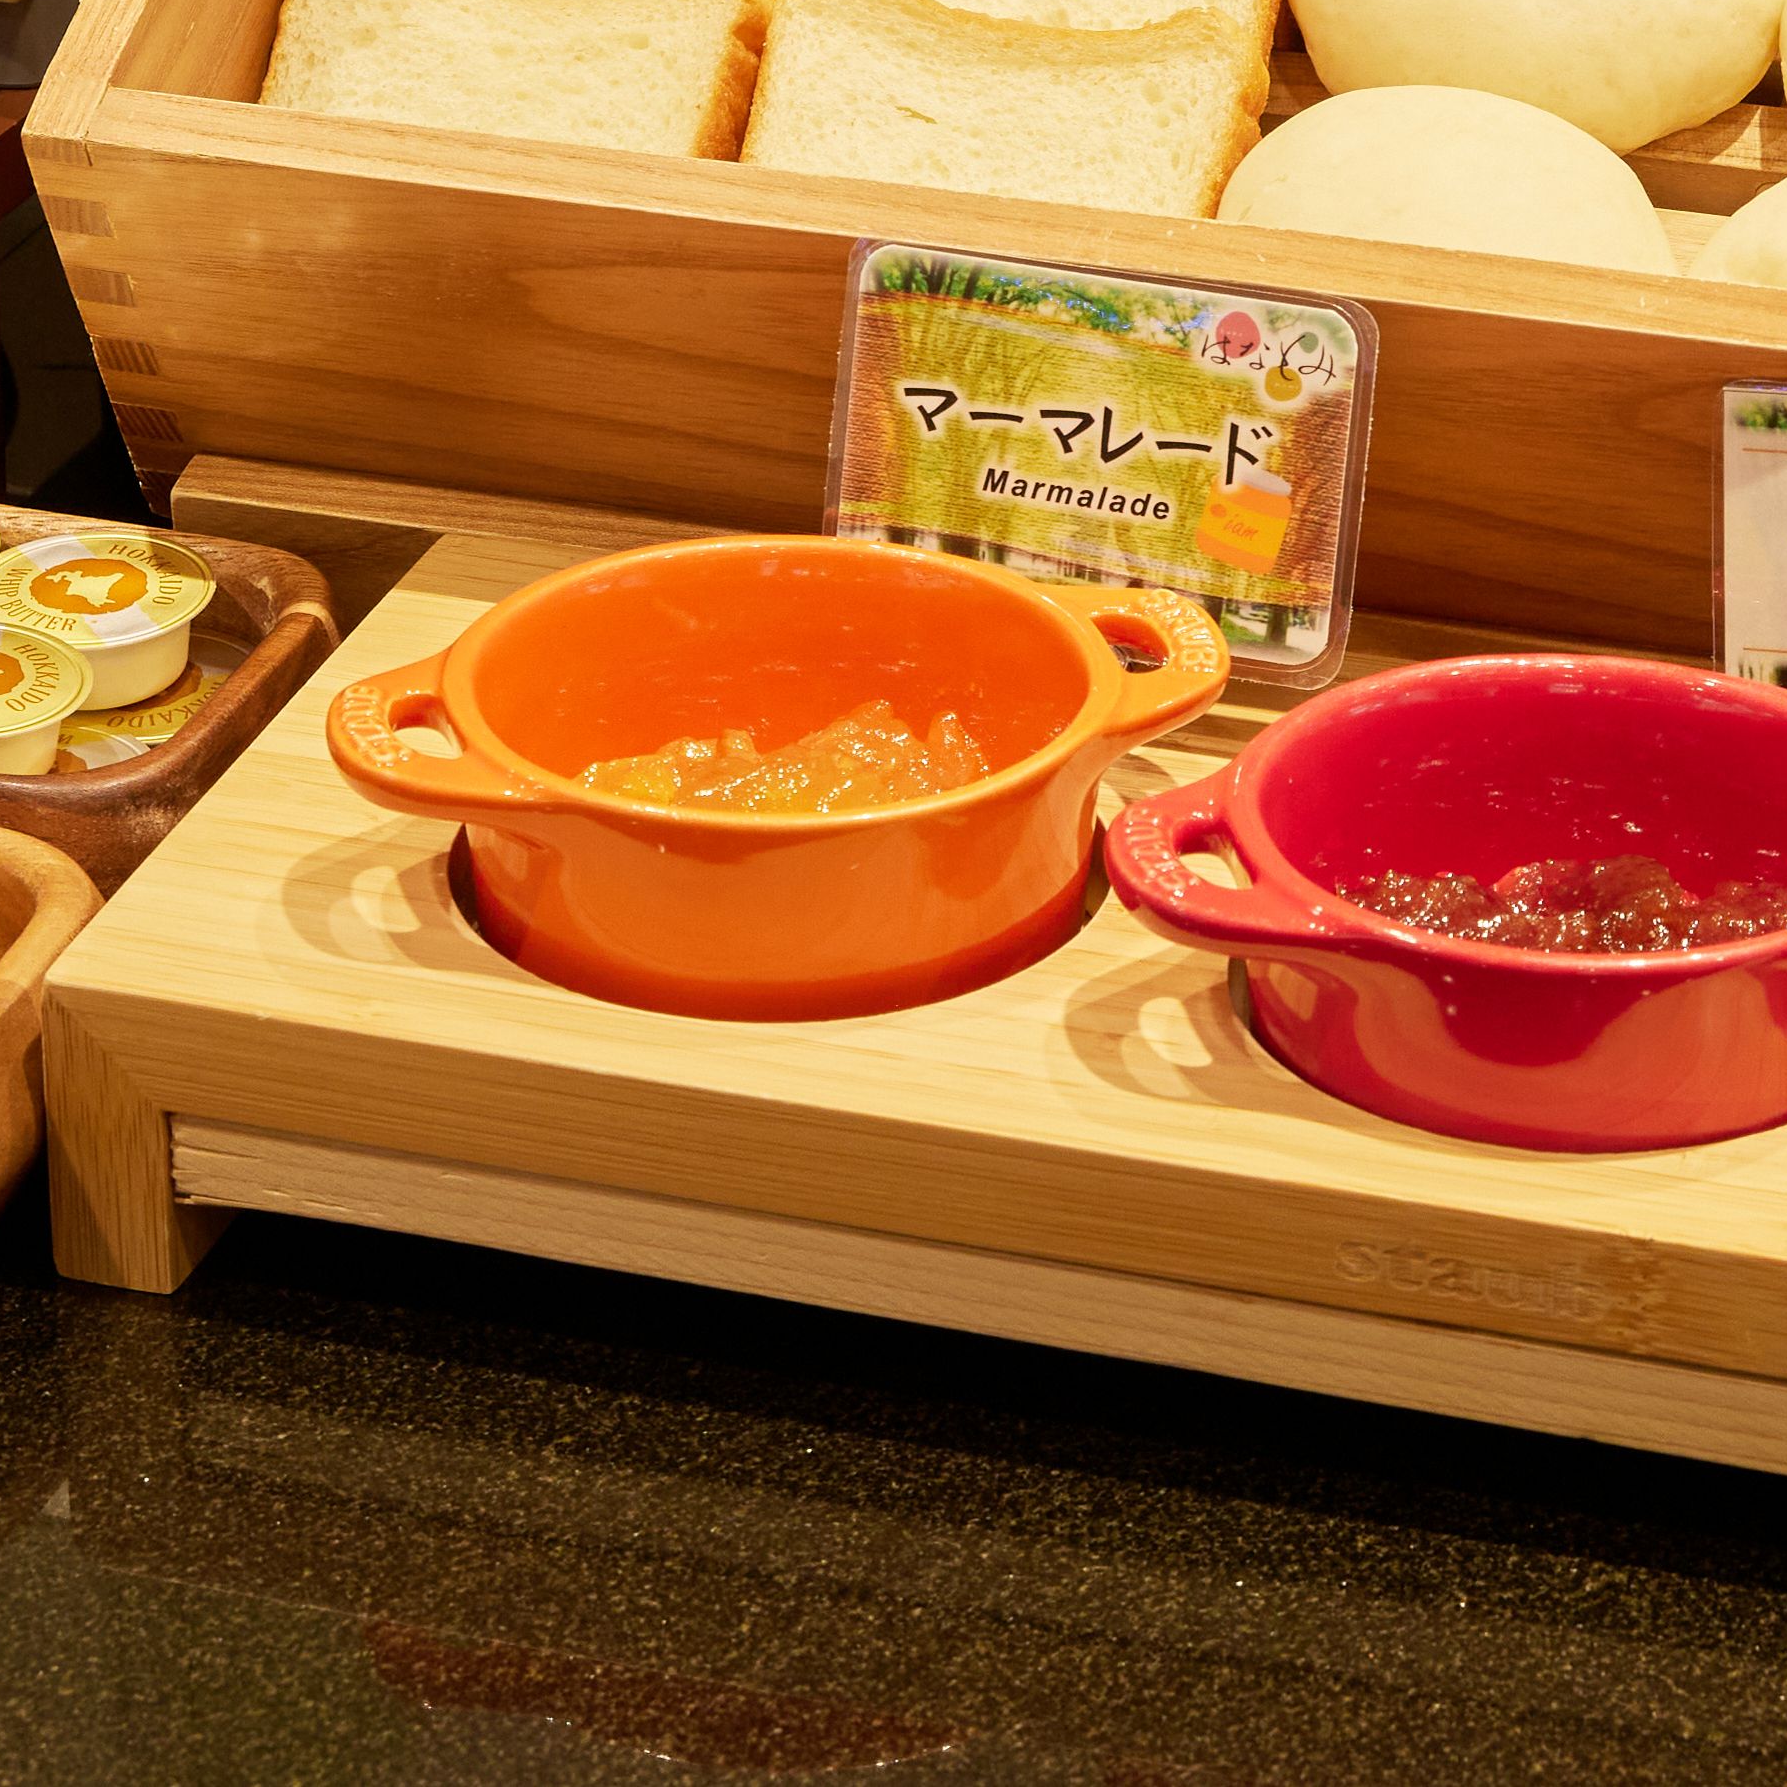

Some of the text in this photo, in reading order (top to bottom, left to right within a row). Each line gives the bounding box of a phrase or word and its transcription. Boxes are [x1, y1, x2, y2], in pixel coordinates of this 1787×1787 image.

[904, 386, 1275, 486] マーマレード
[982, 467, 1172, 521] Marmalade
[108, 544, 183, 607] HOKKAIDO
[0, 598, 77, 632] BUTTER
[5, 643, 61, 713] HOKKAIDO
